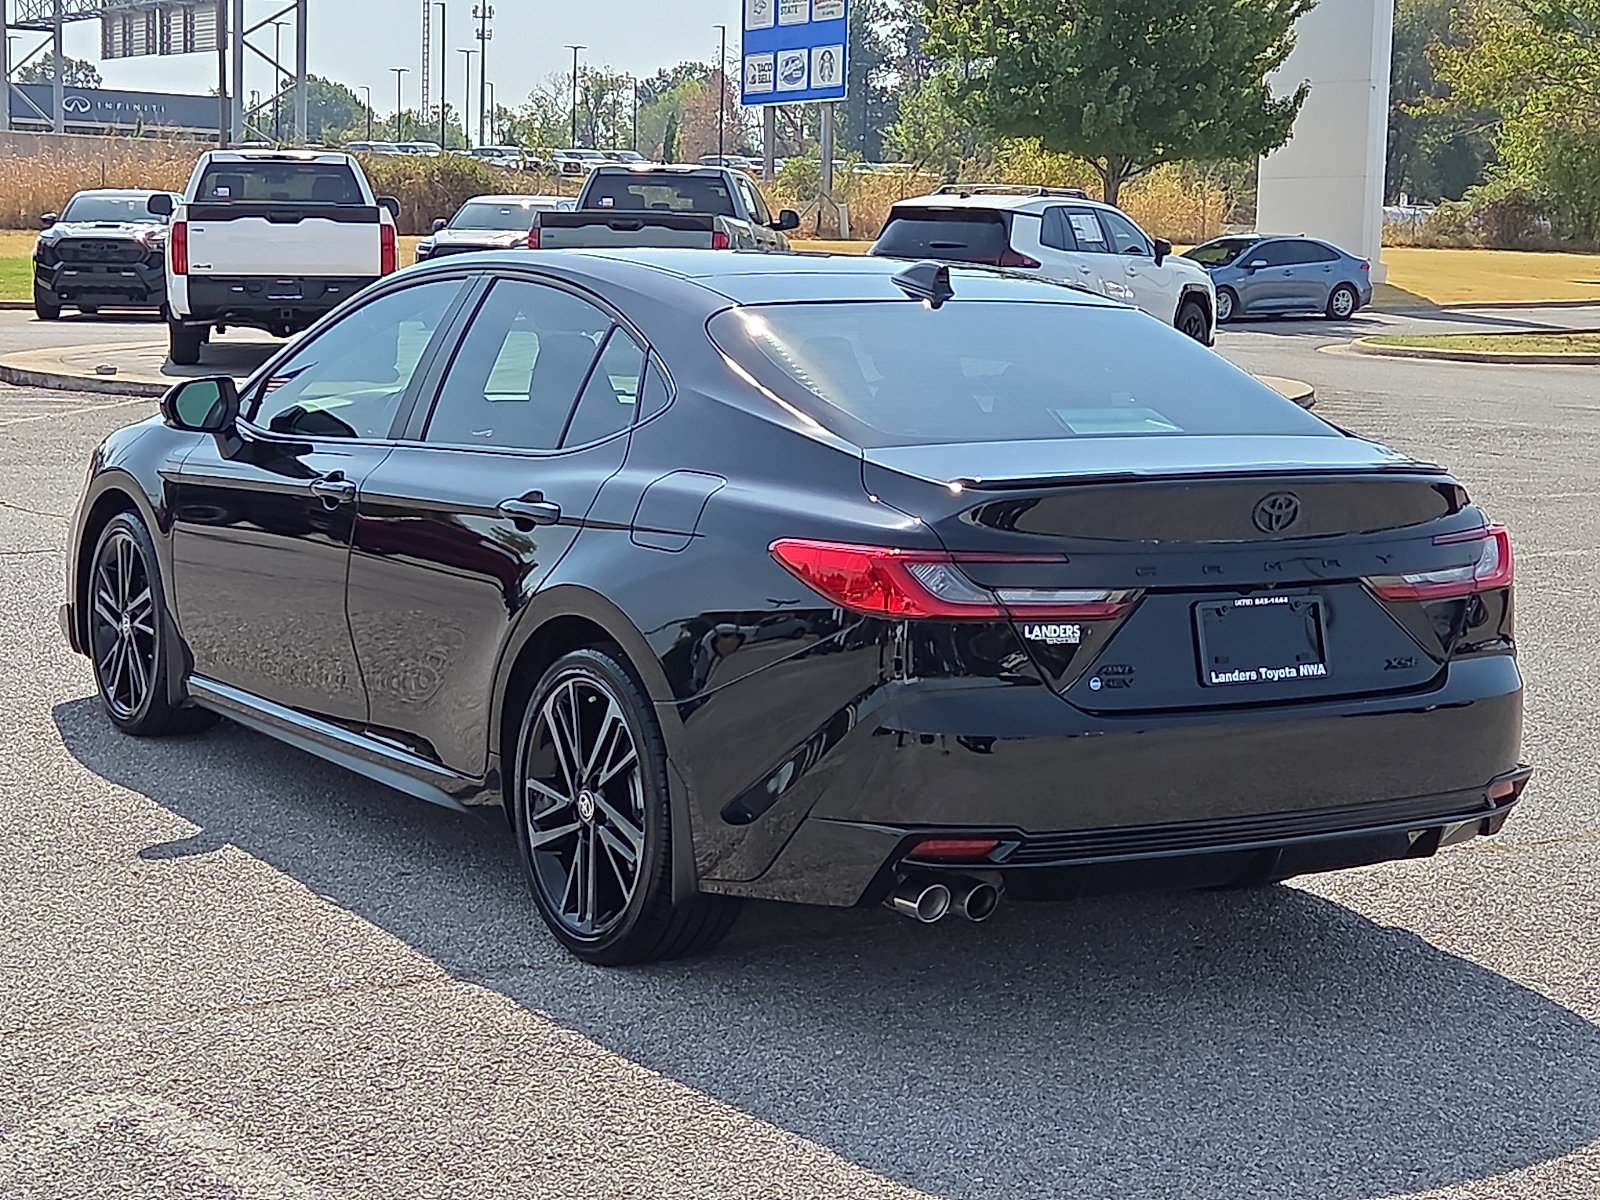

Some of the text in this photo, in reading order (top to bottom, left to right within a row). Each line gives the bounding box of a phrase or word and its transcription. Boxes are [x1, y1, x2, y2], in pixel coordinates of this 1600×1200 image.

[757, 62, 773, 72] TACO
[757, 73, 772, 84] BELL
[97, 101, 166, 113] INFINITI
[1024, 624, 1081, 639] LANDERS
[1211, 663, 1327, 683] Landers Toyota NWA
